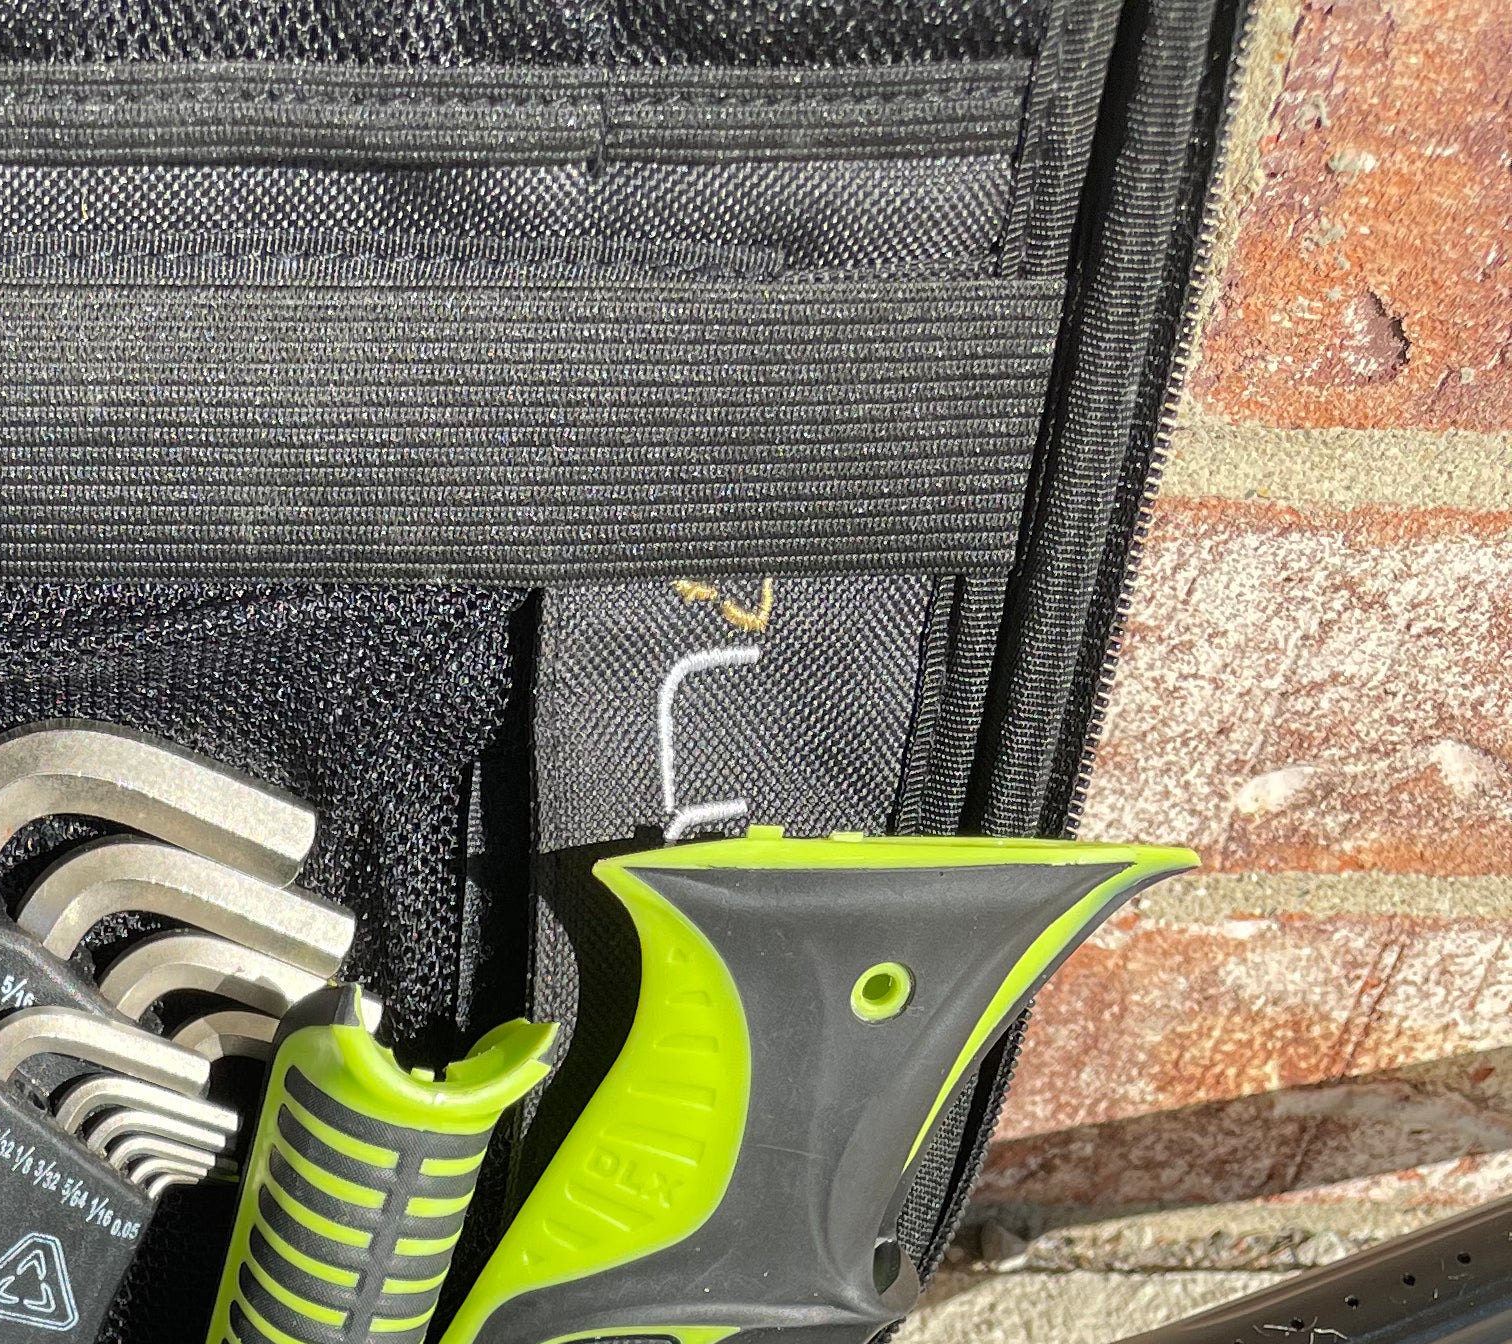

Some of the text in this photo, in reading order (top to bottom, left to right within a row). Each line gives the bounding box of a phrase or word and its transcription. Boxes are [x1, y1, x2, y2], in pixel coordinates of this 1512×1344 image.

[11, 1146, 36, 1175] 1/8
[33, 1160, 61, 1190] 3/32
[60, 1178, 89, 1208] 5/64
[85, 1197, 114, 1227] 1/16
[110, 1219, 140, 1239] 0.05
